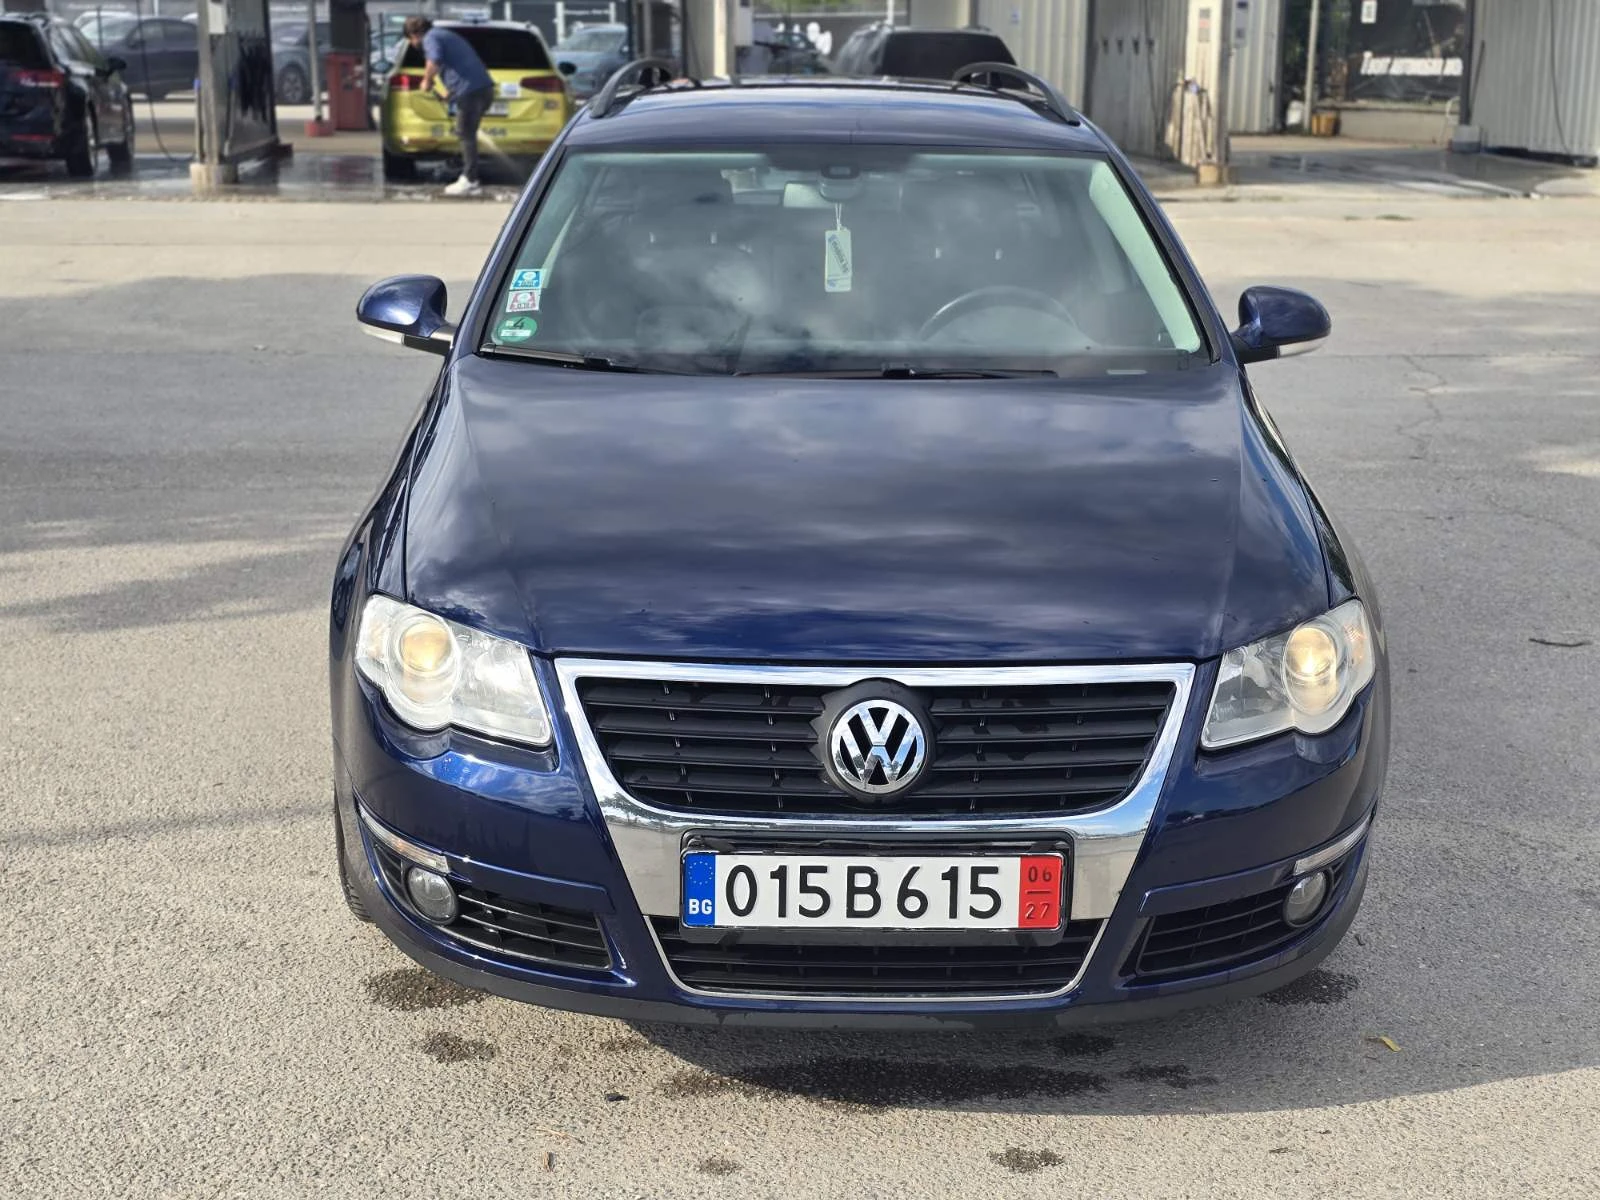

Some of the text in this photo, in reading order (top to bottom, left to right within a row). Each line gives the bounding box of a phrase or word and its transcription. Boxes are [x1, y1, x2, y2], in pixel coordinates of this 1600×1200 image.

[831, 700, 925, 793] VW
[1028, 865, 1052, 882] 06
[688, 898, 712, 915] BG
[1025, 901, 1049, 920] 27
